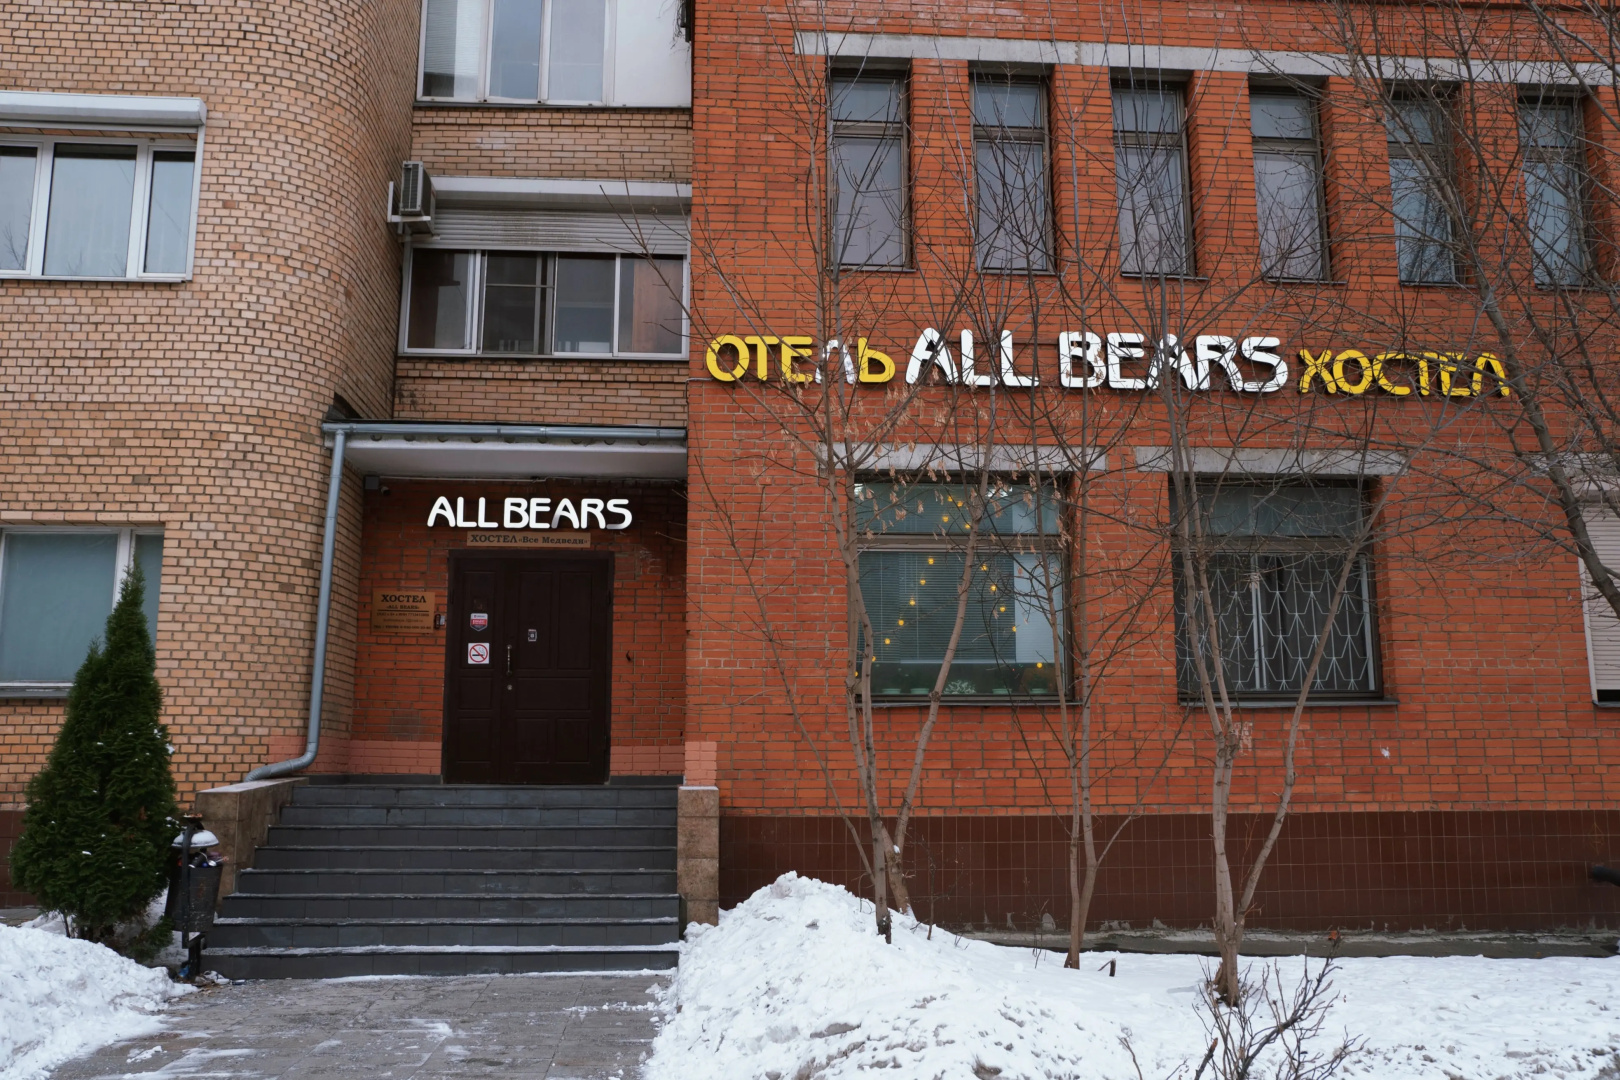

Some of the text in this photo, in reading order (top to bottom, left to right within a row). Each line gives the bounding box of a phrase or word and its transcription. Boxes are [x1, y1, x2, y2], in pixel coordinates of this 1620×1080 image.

[706, 334, 896, 383] ОТЕЛЬ
[905, 327, 1289, 393] ALL BEARS
[1298, 349, 1510, 397] ХОСТЕЛ
[427, 496, 633, 530] ALL BEARS
[470, 534, 518, 544] ХОСТЕЛ
[381, 594, 427, 603] ХОСТЕЛ
